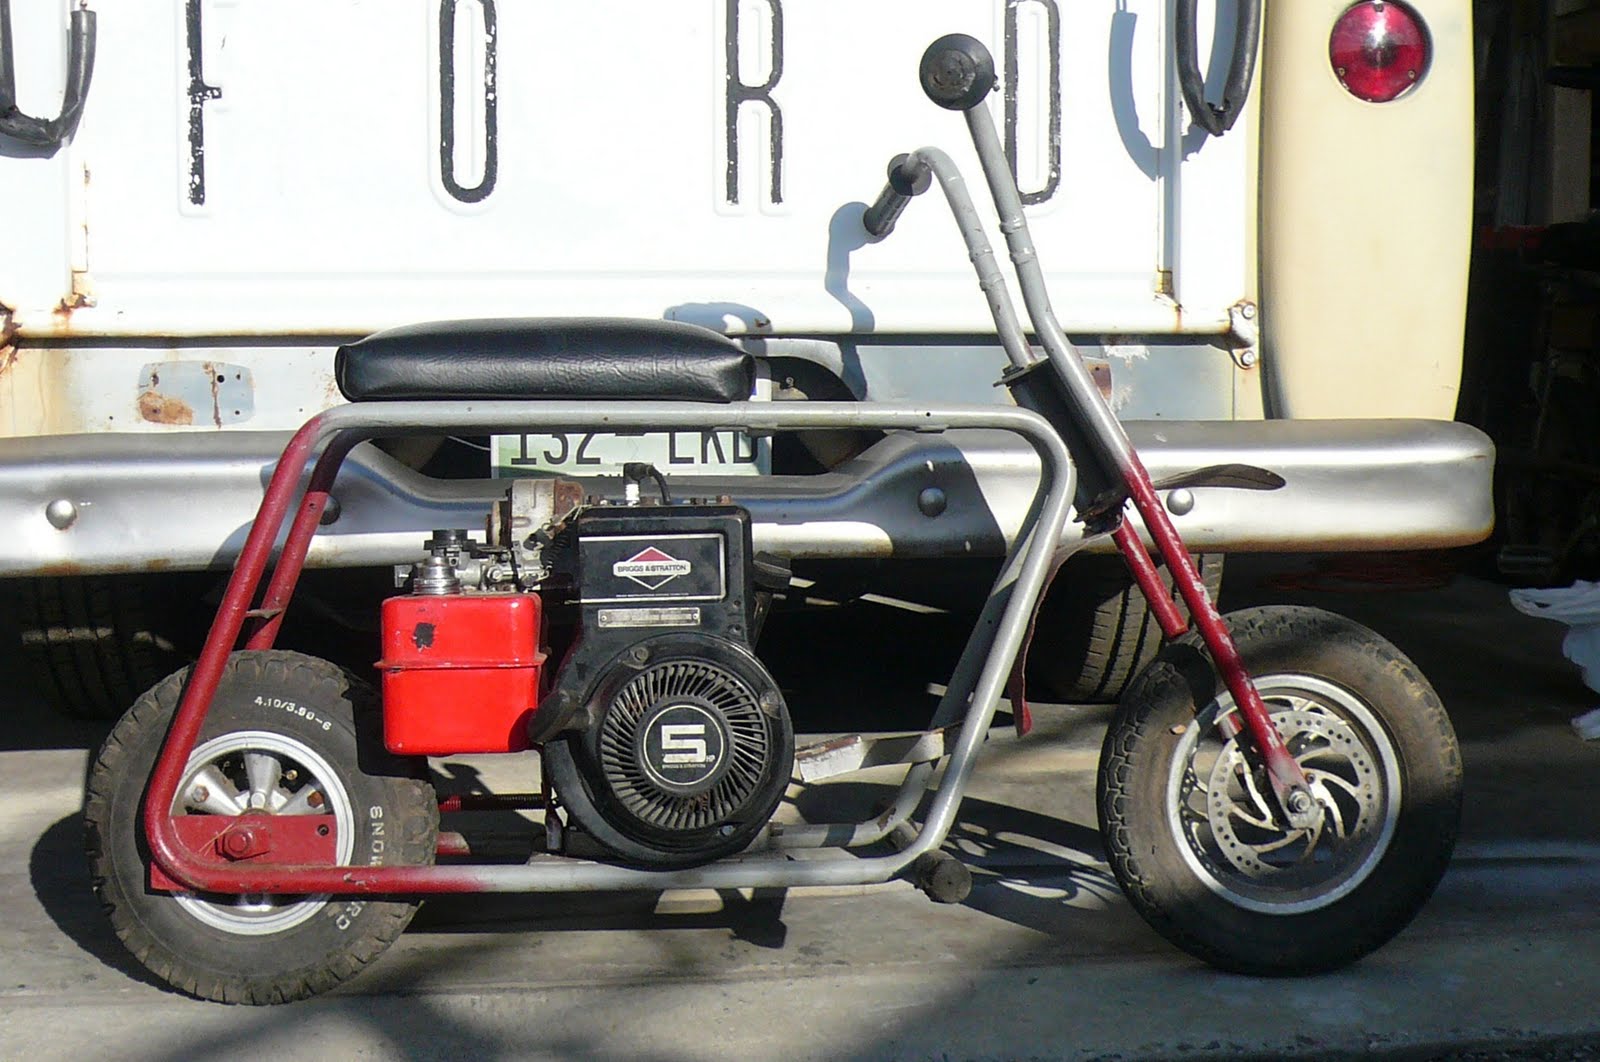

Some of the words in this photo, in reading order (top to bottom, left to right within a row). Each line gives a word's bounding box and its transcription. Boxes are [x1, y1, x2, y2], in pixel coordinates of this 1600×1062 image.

[186, 0, 1061, 205] FORD
[617, 565, 644, 573] BRIGGS
[651, 564, 687, 572] STRATTON
[661, 724, 707, 763] 5
